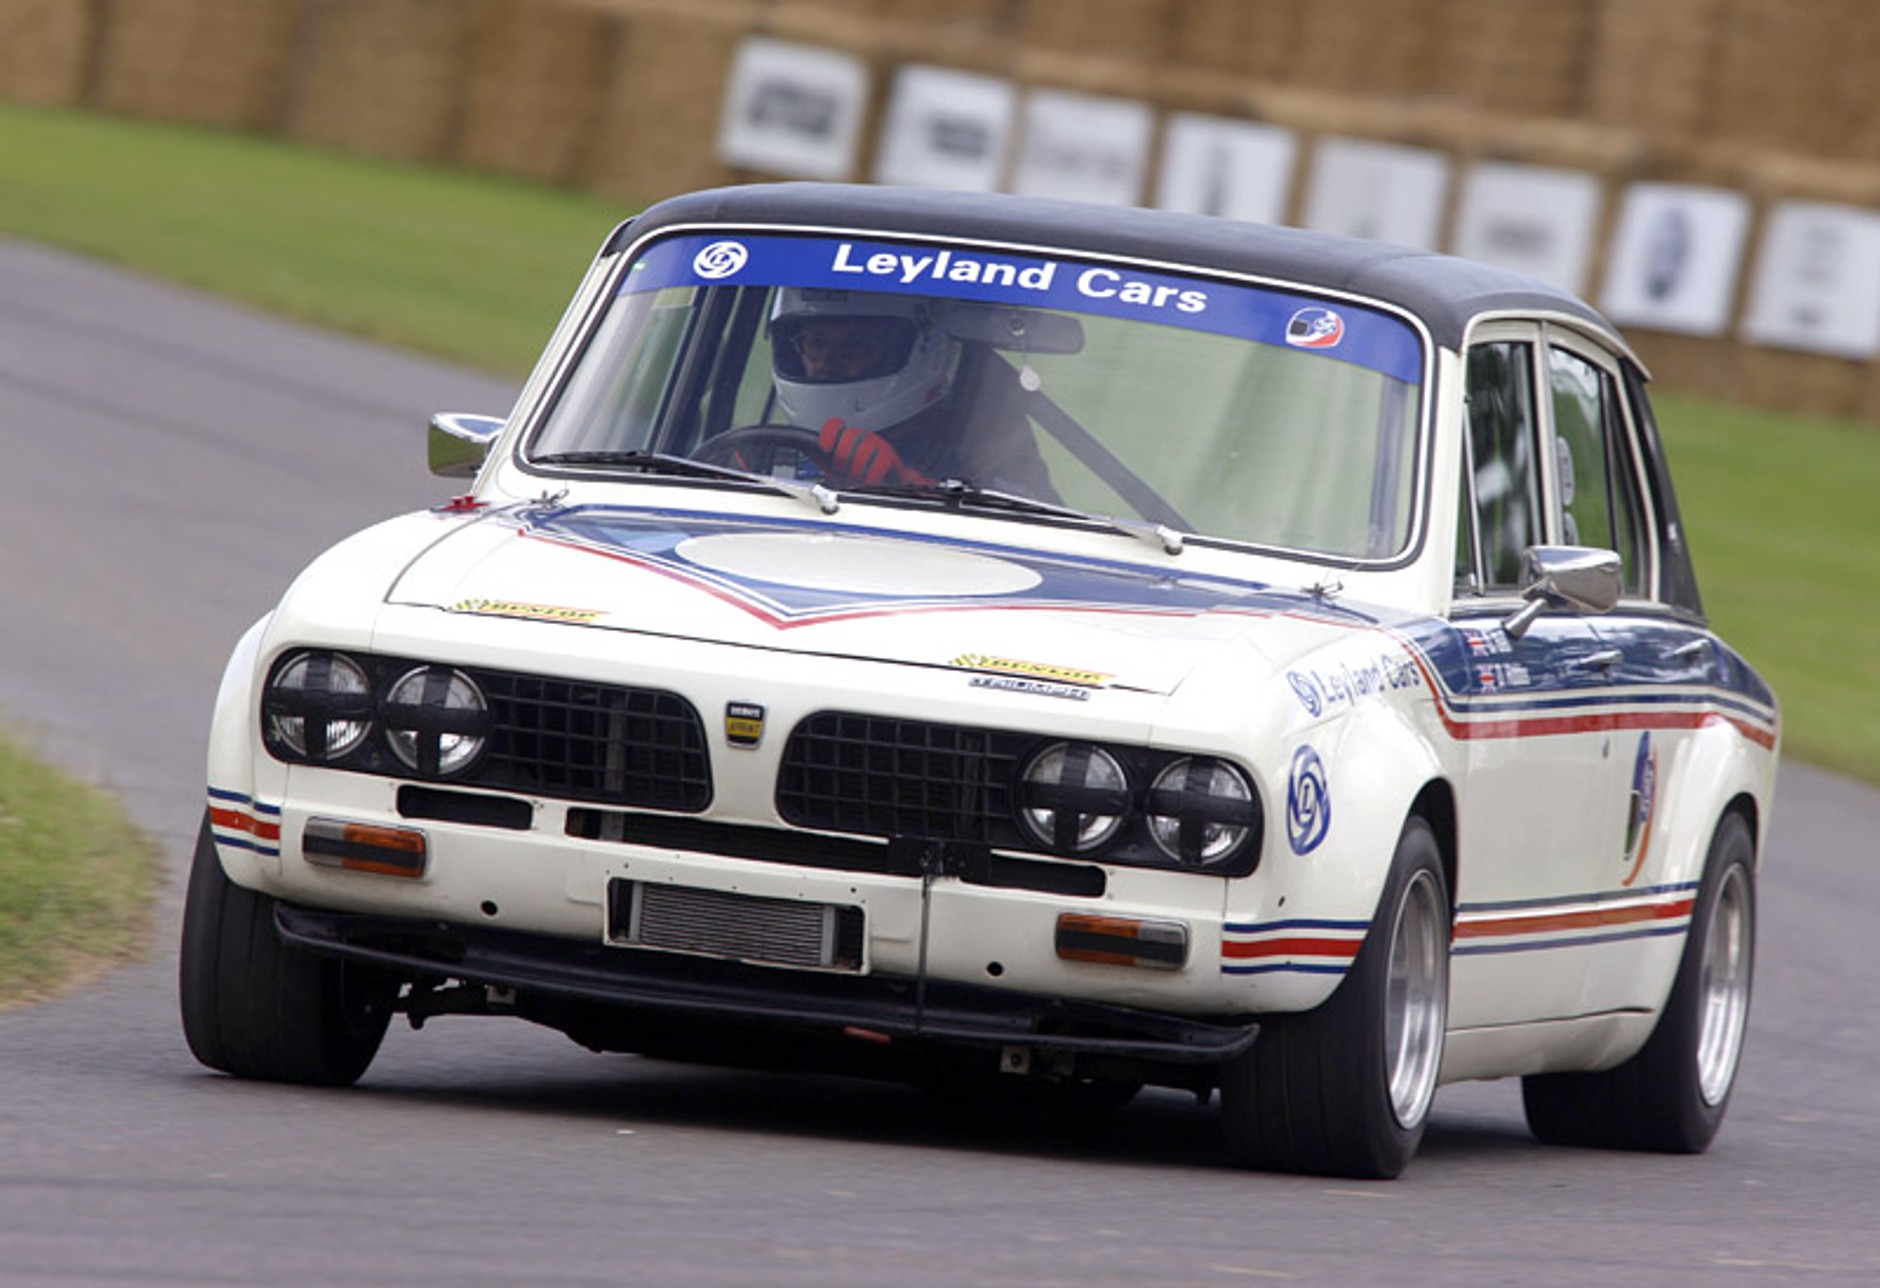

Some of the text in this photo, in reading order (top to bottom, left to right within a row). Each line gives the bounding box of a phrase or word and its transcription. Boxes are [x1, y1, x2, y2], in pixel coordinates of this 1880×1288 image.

[831, 243, 1207, 314] Leyland Cars
[1311, 654, 1420, 706] Leyland Cars
